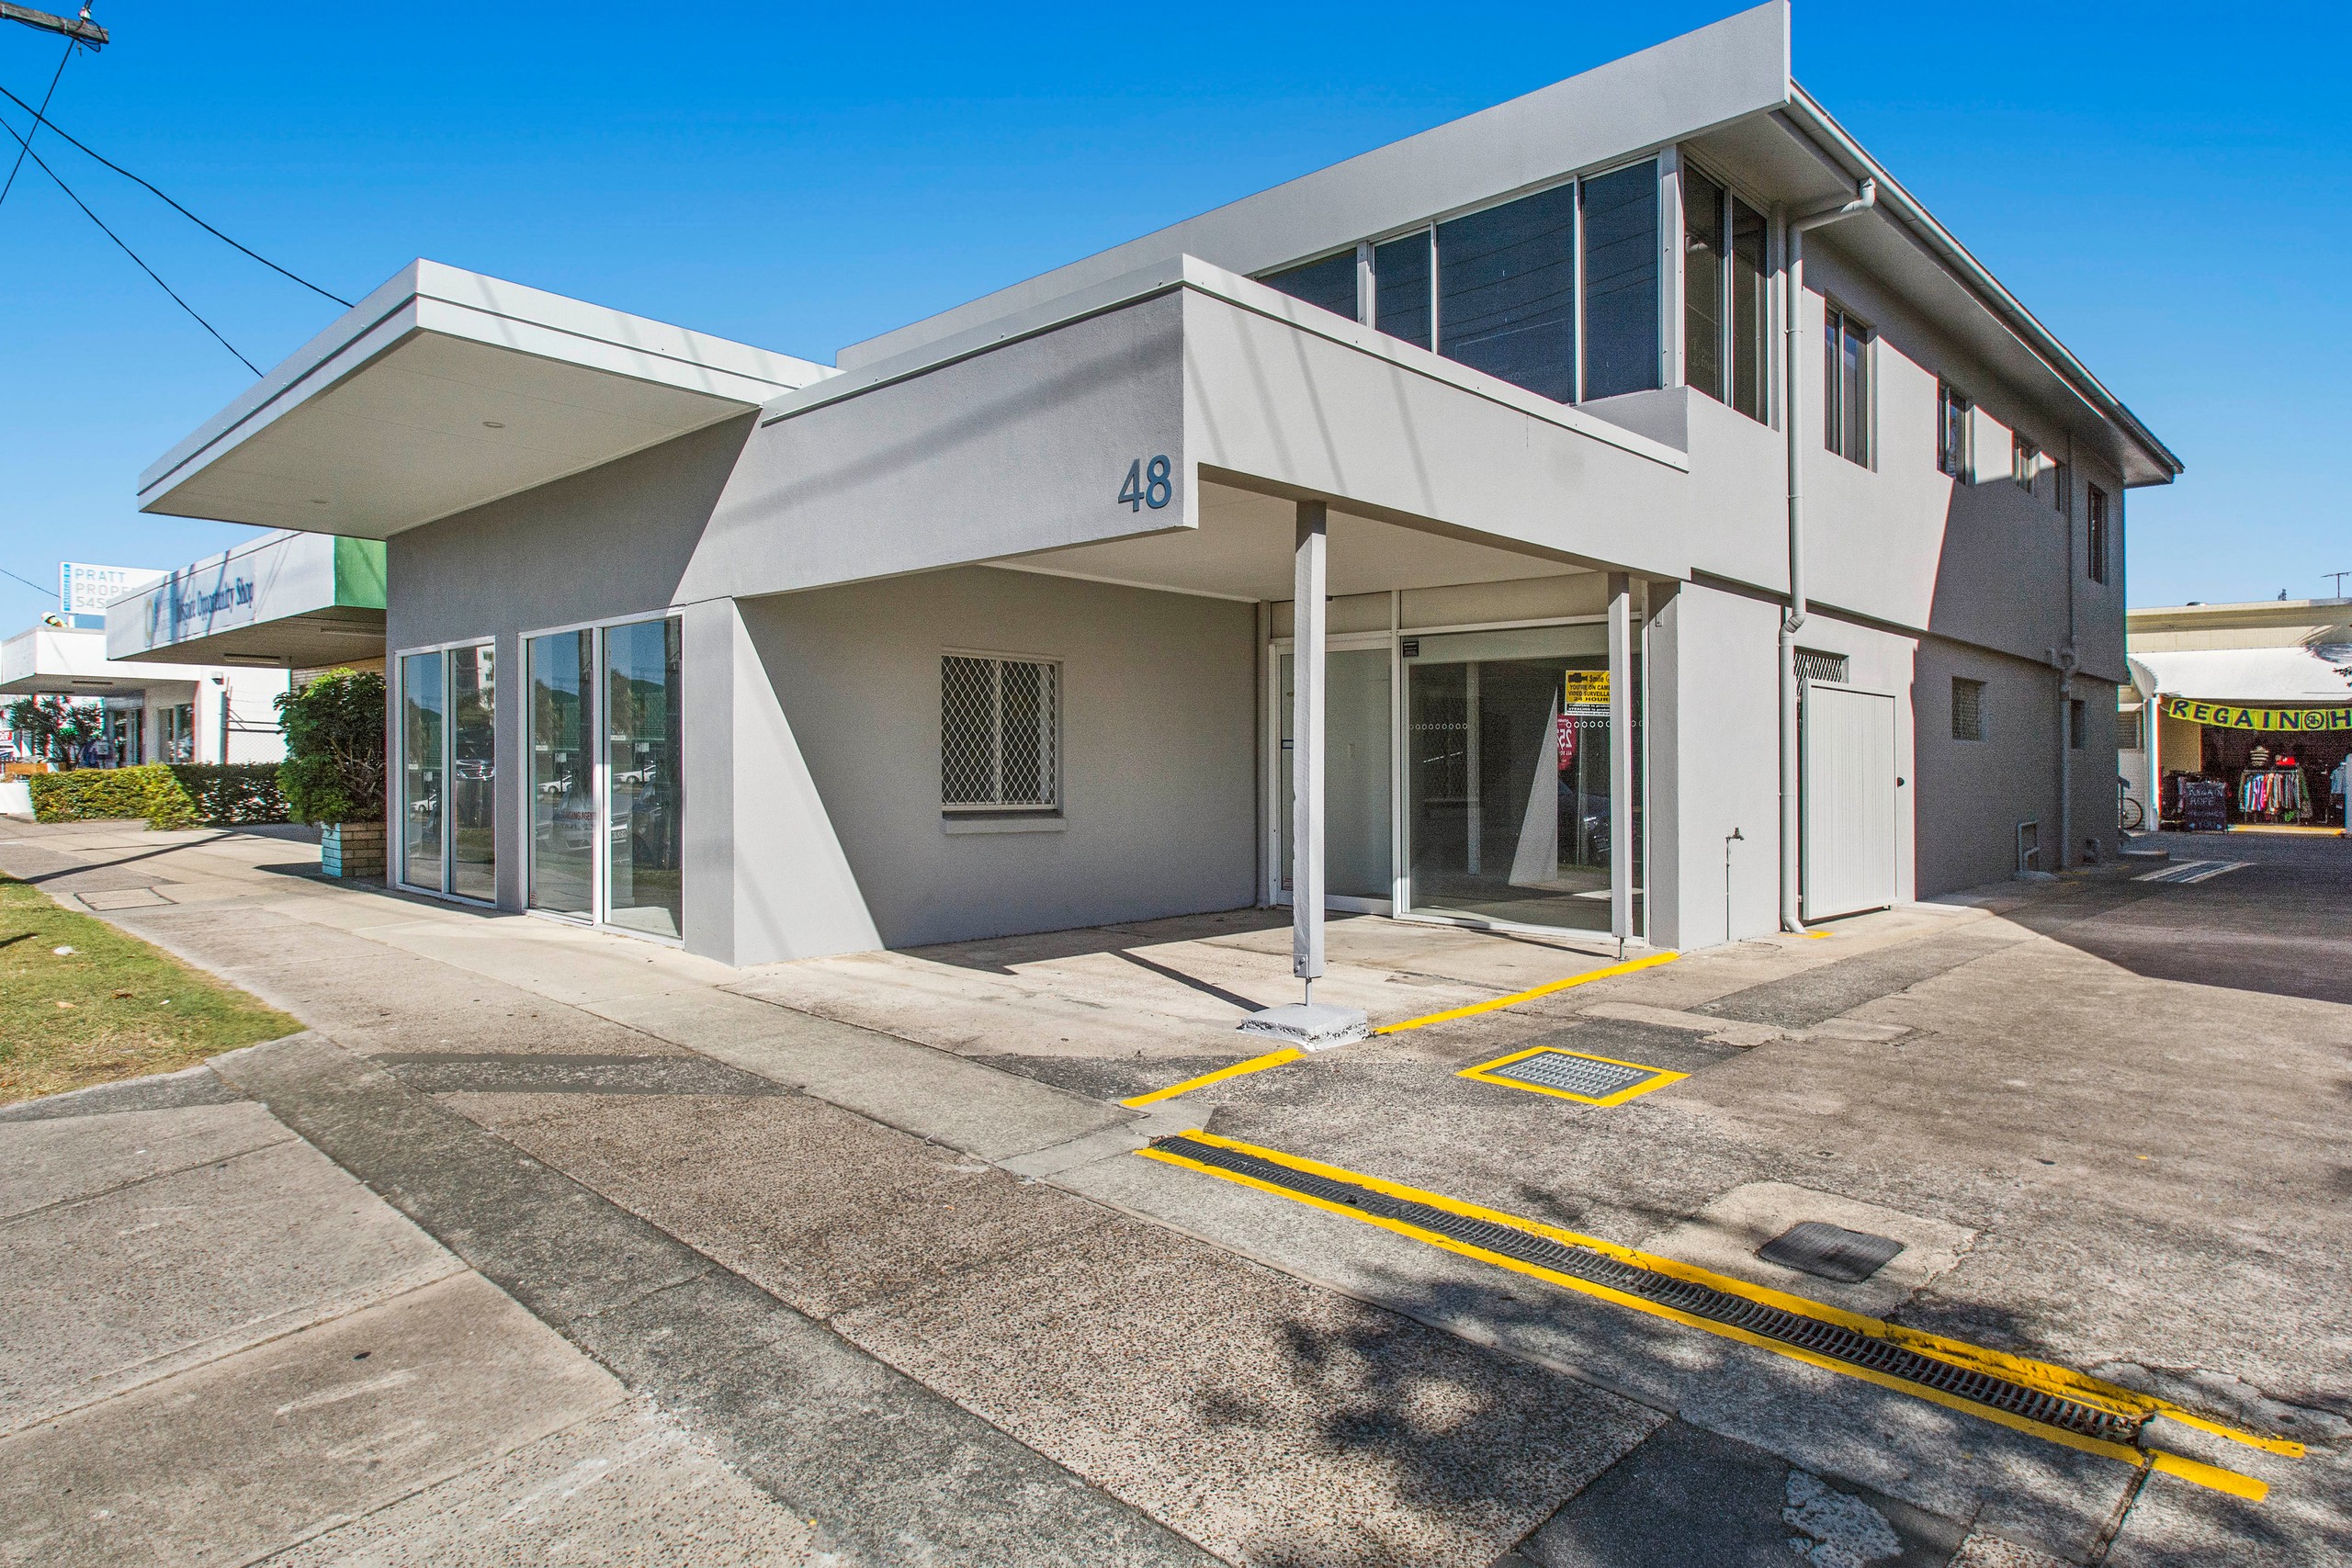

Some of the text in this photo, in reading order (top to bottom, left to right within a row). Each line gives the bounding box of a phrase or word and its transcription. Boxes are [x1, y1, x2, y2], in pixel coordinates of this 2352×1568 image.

[1118, 454, 1171, 513] 48
[76, 569, 126, 582] PRATT
[198, 581, 234, 621] Opportunity
[235, 577, 254, 609] Shop
[1589, 674, 1604, 682] Smile
[2172, 700, 2301, 729] REGAIN
